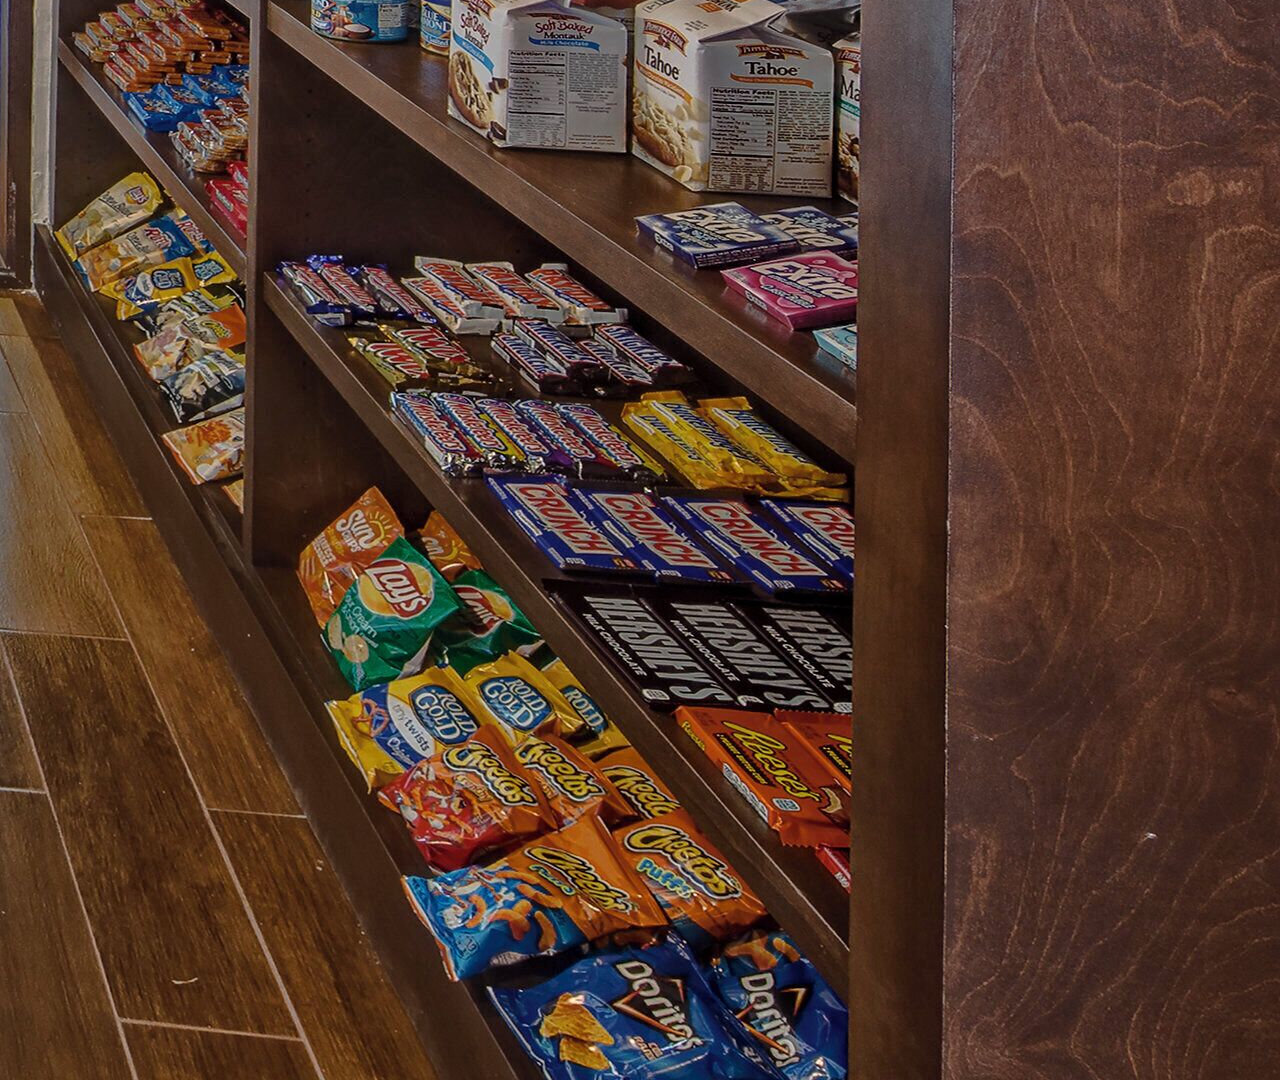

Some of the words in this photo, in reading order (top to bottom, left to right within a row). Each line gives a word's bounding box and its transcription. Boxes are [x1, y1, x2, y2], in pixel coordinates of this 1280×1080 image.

[535, 21, 556, 33] Soft
[559, 20, 594, 35] Baked
[644, 45, 680, 81] Tahoe
[744, 61, 799, 76] Tahoe
[518, 486, 612, 555] CRUNCH
[604, 493, 709, 567] CRUNCH
[701, 504, 818, 574] CRUNCH
[365, 563, 427, 618] Lay's
[352, 606, 378, 638] Cream
[583, 613, 602, 633] MILK
[600, 630, 648, 677] CHOCOLATE
[670, 619, 690, 640] MILK
[688, 637, 740, 683] CHOCOLATE
[763, 624, 784, 645] MILK
[781, 642, 836, 690] CHOCOLATE
[415, 693, 462, 741] GOLD
[436, 688, 477, 734] ROLD
[484, 681, 534, 730] GOLD
[506, 677, 547, 716] ROLD
[563, 688, 606, 731] ROLD
[403, 718, 431, 752] twists
[444, 743, 538, 806] Cheetos
[525, 845, 640, 913] Cheetos
[626, 824, 742, 900] Cheetos
[615, 960, 705, 1052] Doritos
[741, 972, 799, 1068] Doritos
